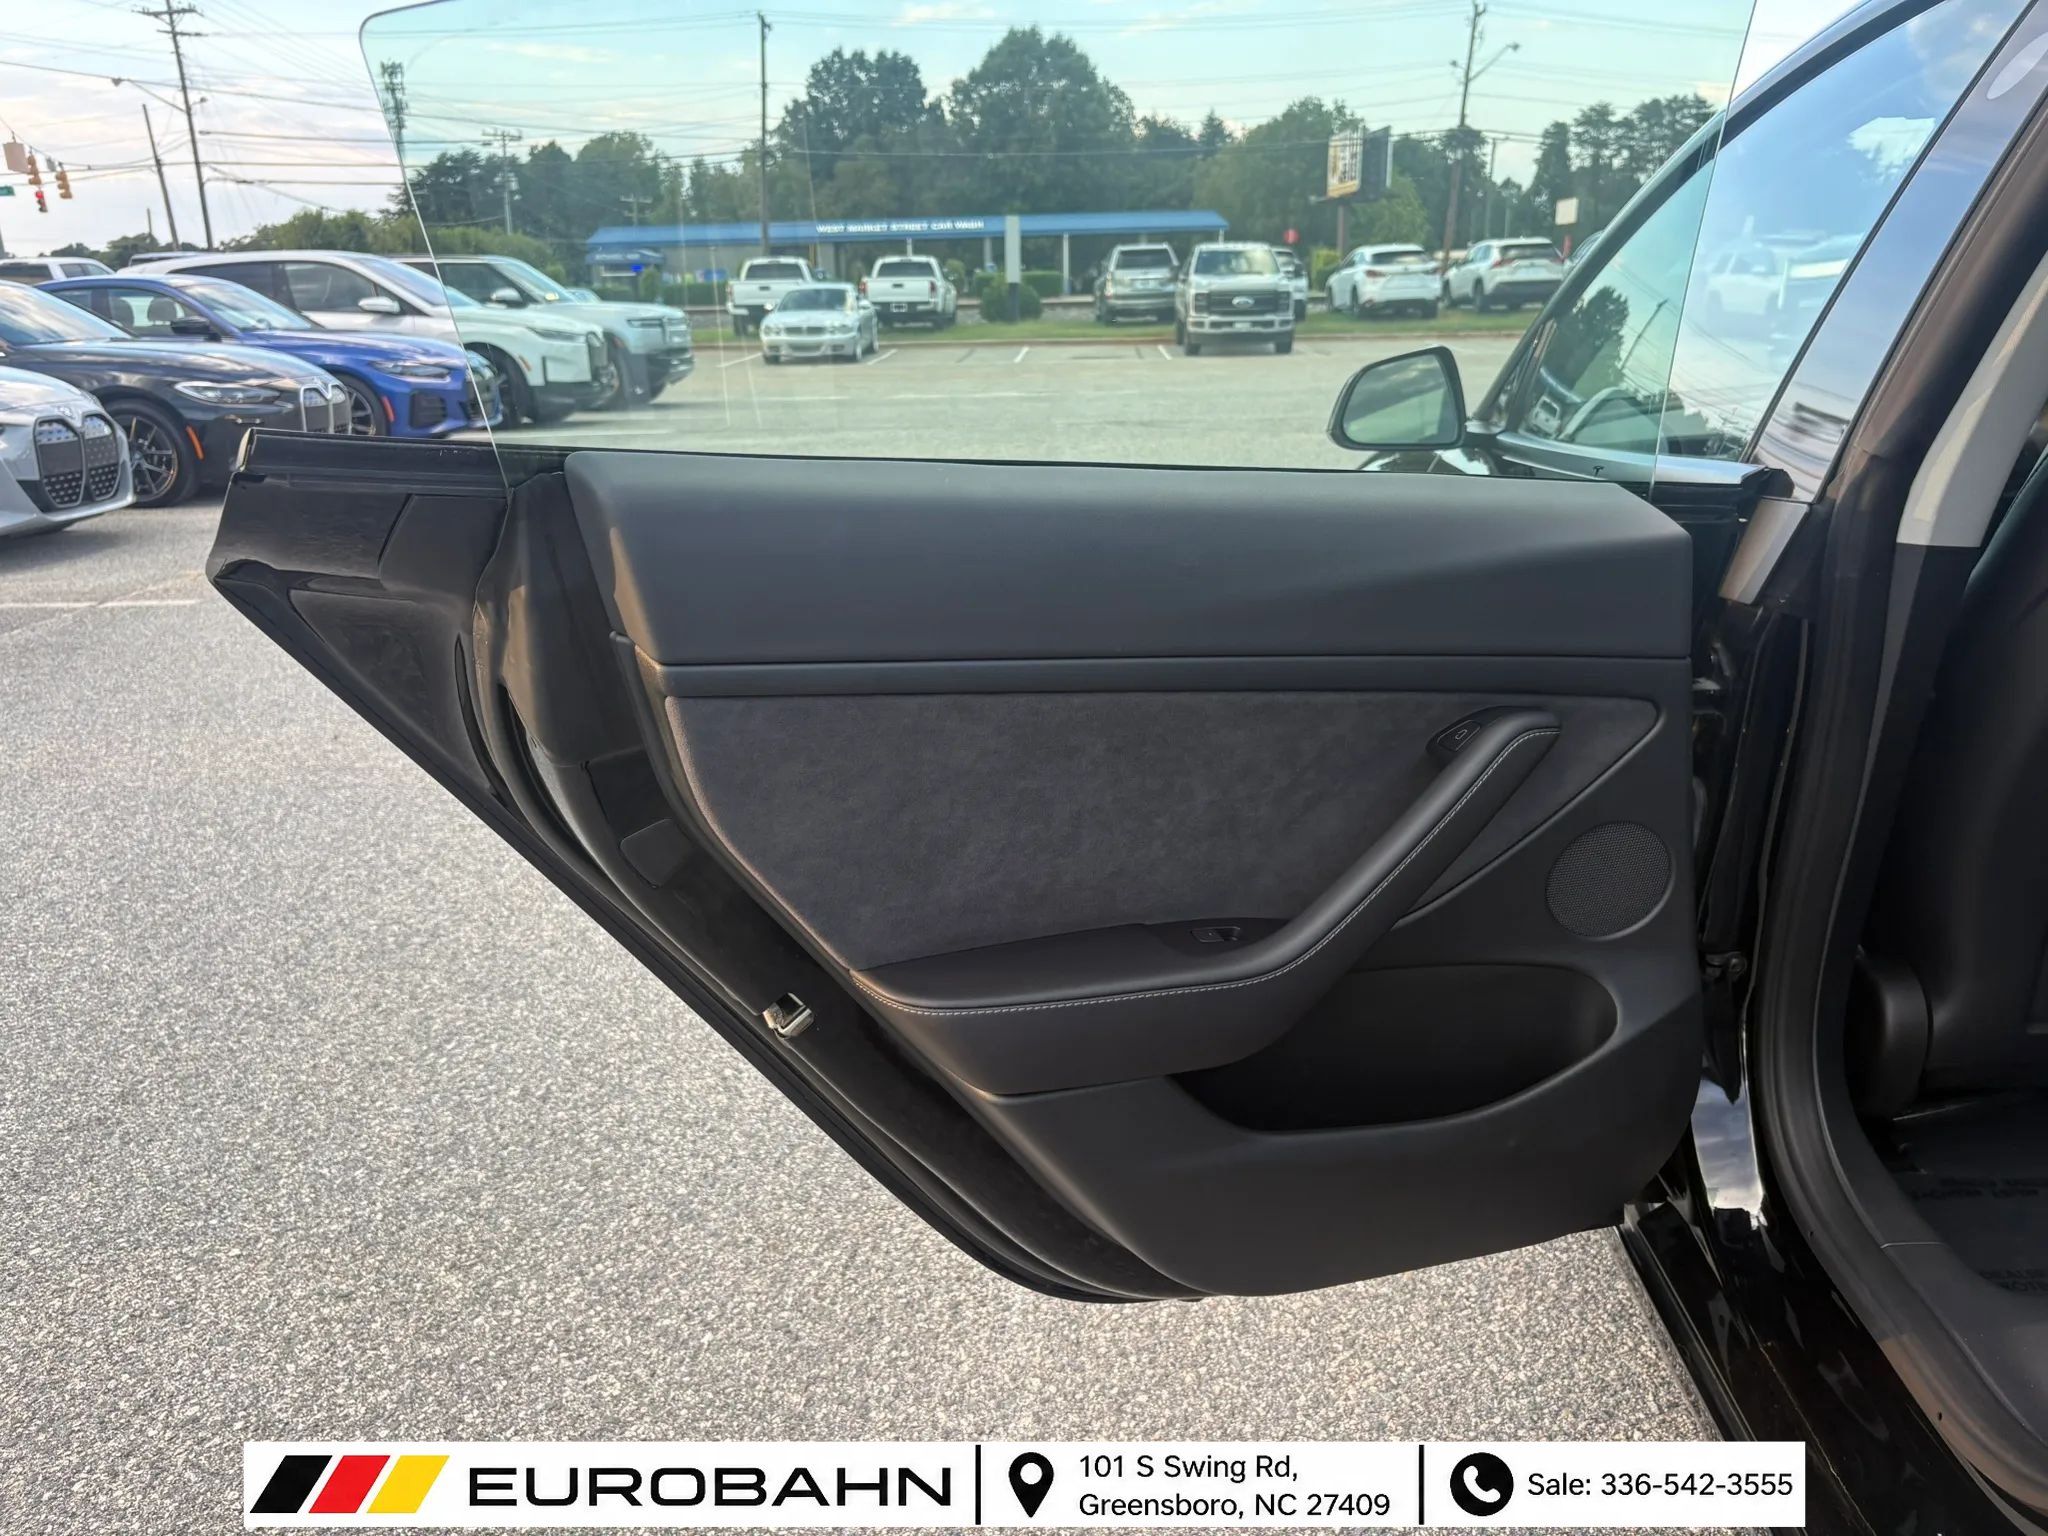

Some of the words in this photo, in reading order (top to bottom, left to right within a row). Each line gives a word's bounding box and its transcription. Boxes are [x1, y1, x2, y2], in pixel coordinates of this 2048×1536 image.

[890, 221, 929, 232] STREET
[930, 220, 953, 231] CAR
[954, 219, 985, 230] WASH
